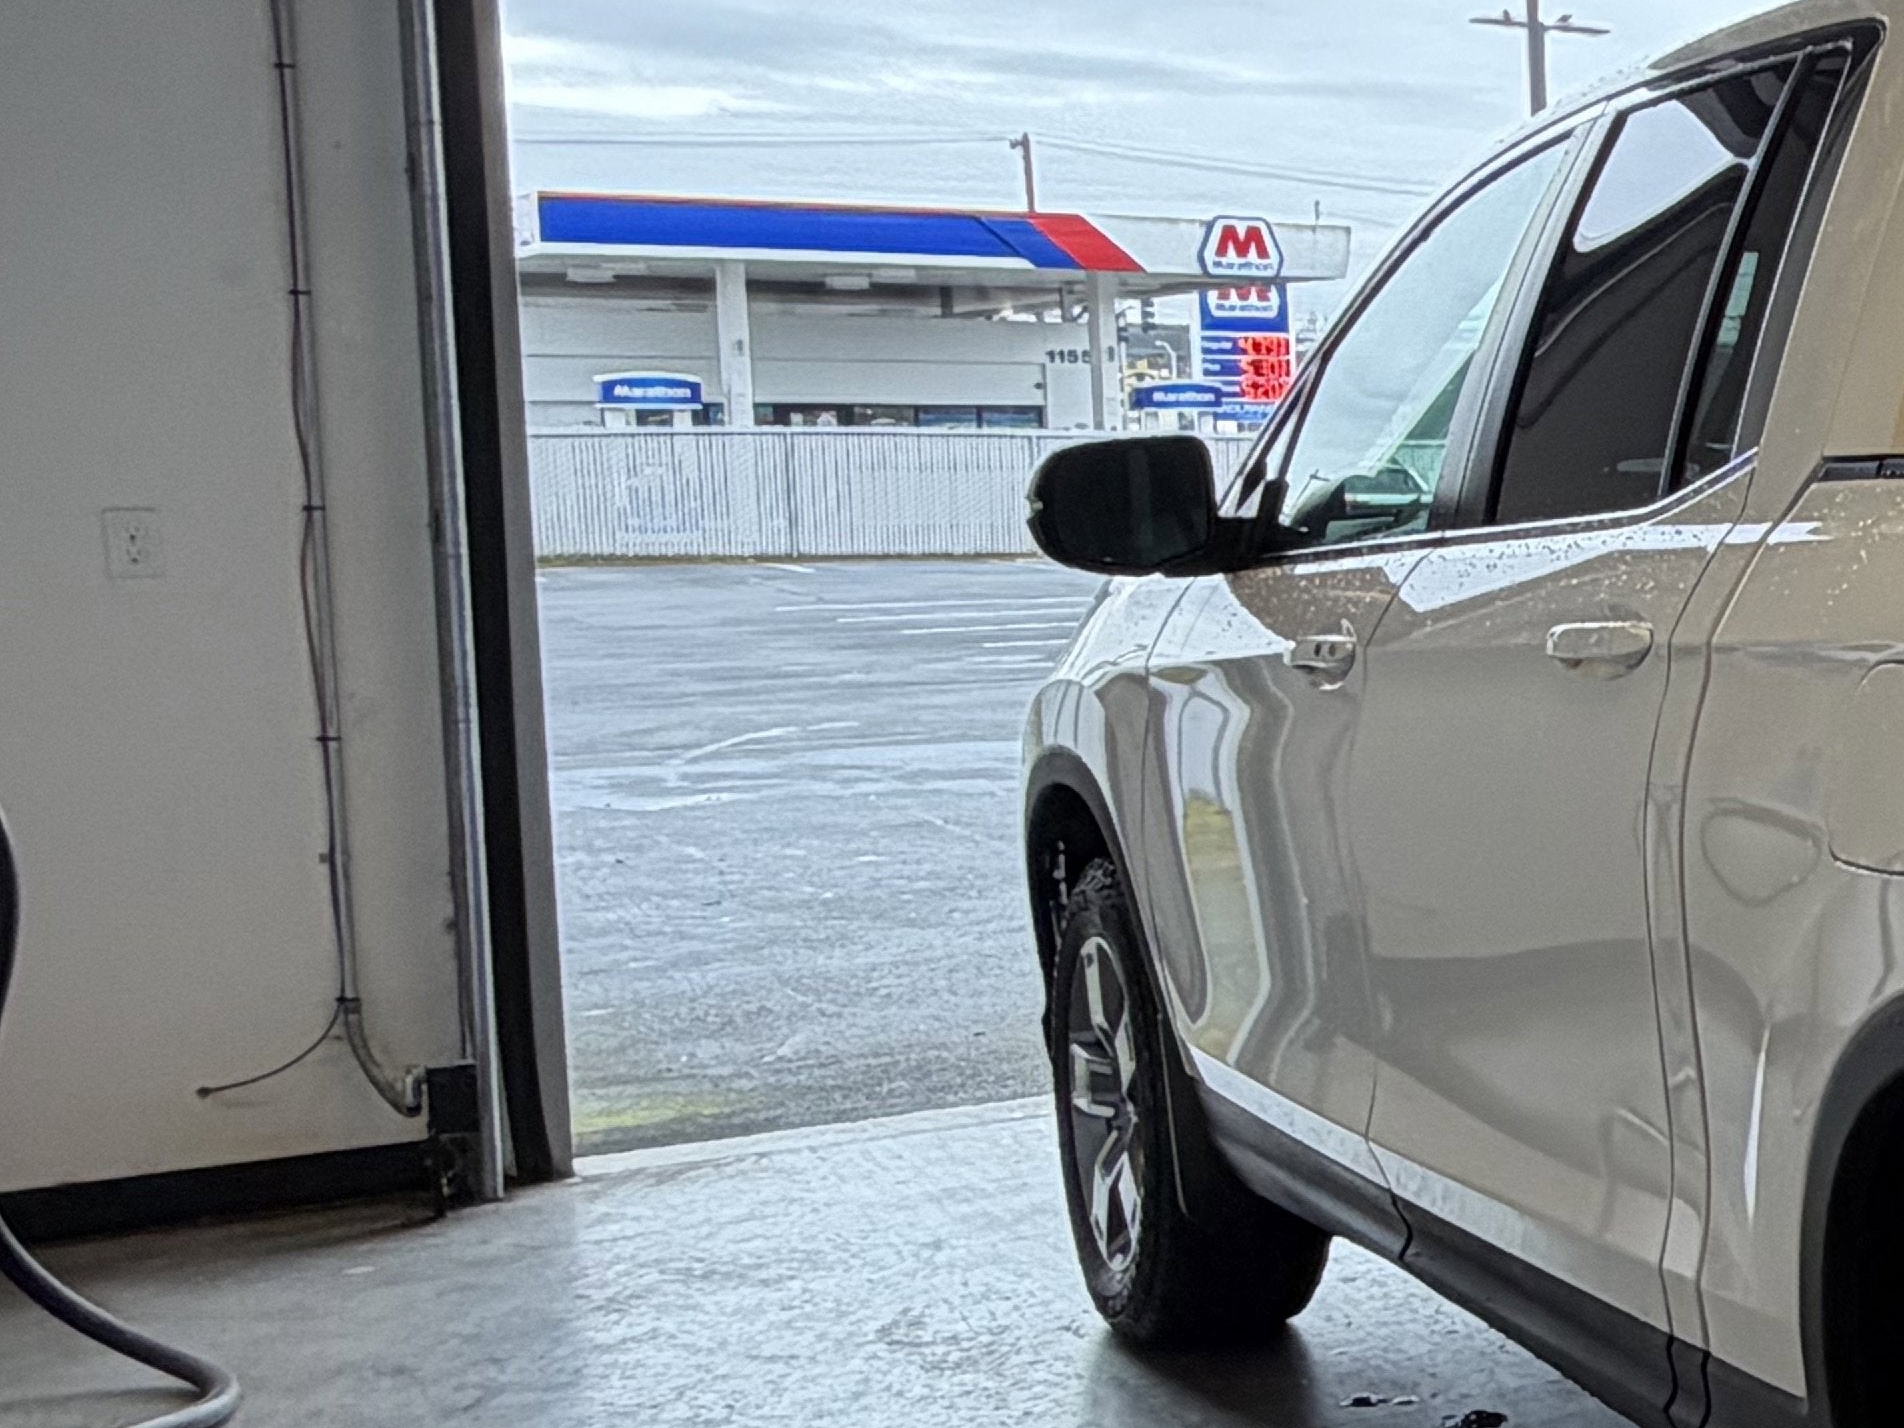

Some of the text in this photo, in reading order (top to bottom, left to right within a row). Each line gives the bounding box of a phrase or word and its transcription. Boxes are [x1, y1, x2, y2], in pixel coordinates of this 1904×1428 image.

[1214, 224, 1271, 260] M
[613, 384, 692, 398] Marathon
[1152, 391, 1216, 402] Marathon
